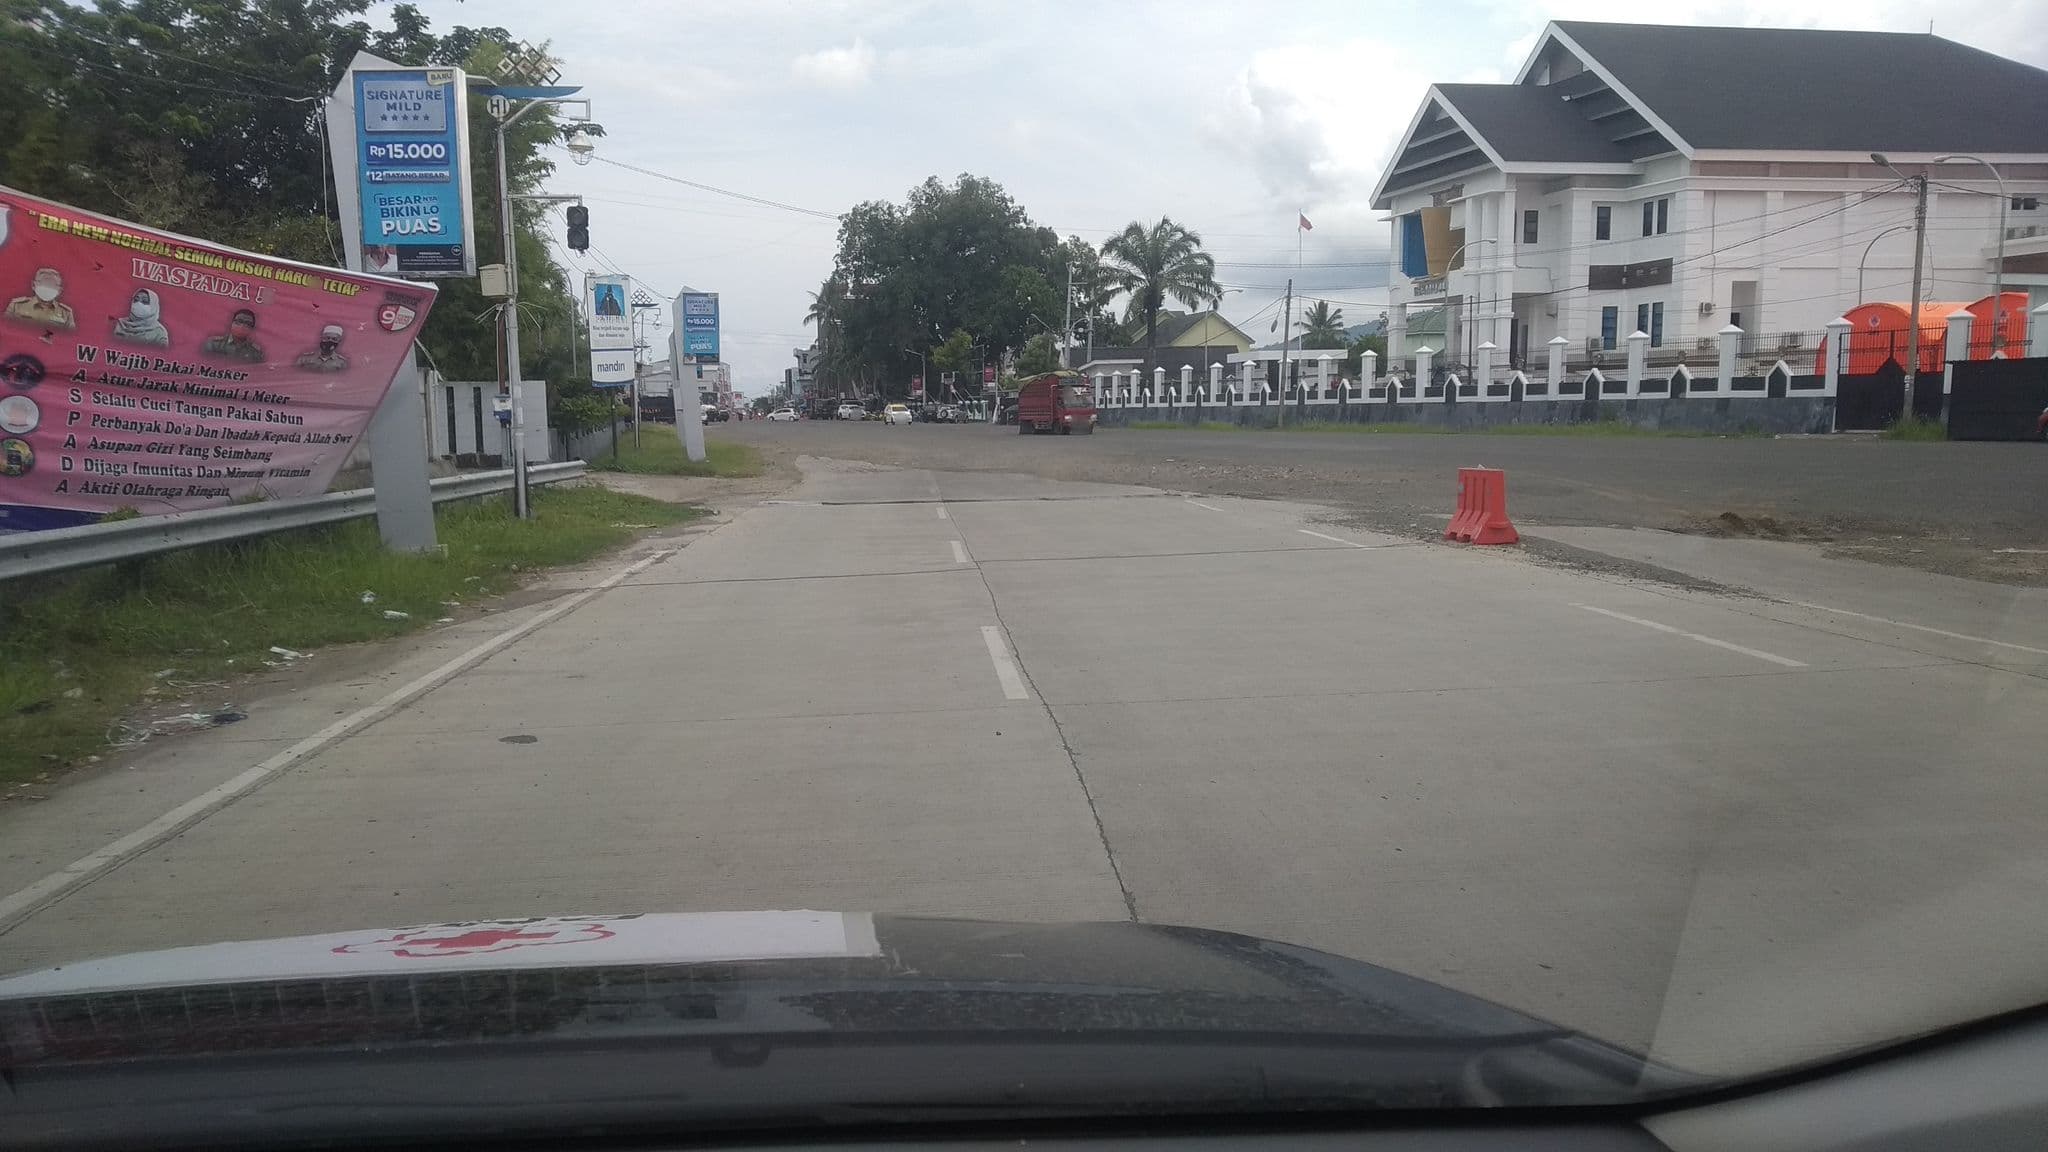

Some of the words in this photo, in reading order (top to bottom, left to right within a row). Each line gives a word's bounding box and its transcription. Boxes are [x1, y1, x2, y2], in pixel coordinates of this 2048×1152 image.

[366, 90, 443, 101] SIGNATURE
[385, 102, 422, 111] MILD
[369, 143, 446, 159] Rp15.000
[370, 171, 383, 181] 12
[385, 172, 418, 180] BATANG
[380, 205, 421, 218] BIKIN
[423, 205, 440, 215] LO
[381, 217, 442, 237] PUAS
[71, 220, 108, 241] NEW
[110, 230, 172, 257] NORMAL
[174, 247, 223, 269] SEMUA
[226, 258, 273, 279] UNSUR
[274, 267, 322, 288] HARU
[132, 258, 250, 301] WASPADA
[78, 345, 97, 362] W
[105, 349, 150, 370] Wajib
[153, 358, 195, 375] Pakai
[196, 364, 249, 381] Masker
[72, 369, 87, 382] A
[137, 377, 179, 393] Jarak
[182, 382, 239, 401] Minimal
[252, 390, 291, 405] Meter
[70, 388, 82, 403] S
[92, 390, 136, 408] Selalu
[140, 396, 171, 412] Cuci
[175, 400, 223, 419] Tangan
[226, 405, 262, 422] Pakai
[264, 409, 304, 425] Sabun
[68, 411, 81, 426] P
[91, 413, 161, 434] Perbanyak
[164, 421, 191, 436] Do'a
[194, 424, 218, 439] Dan
[220, 427, 260, 442] Ibadah
[261, 430, 301, 445] Kepada
[303, 431, 332, 445] Allah
[63, 434, 77, 449] A
[87, 436, 143, 454] Asupan
[145, 441, 176, 455] Gizi
[178, 443, 210, 460] Yang
[213, 445, 274, 463] Seimbang
[61, 456, 74, 471] D
[83, 457, 128, 477] Dijaga
[132, 461, 193, 478] Imunitas
[196, 465, 222, 479] Dan
[55, 479, 69, 493] A
[78, 480, 120, 496] Aktif
[121, 482, 183, 499] Olahraga
[185, 484, 231, 498] Ringan
